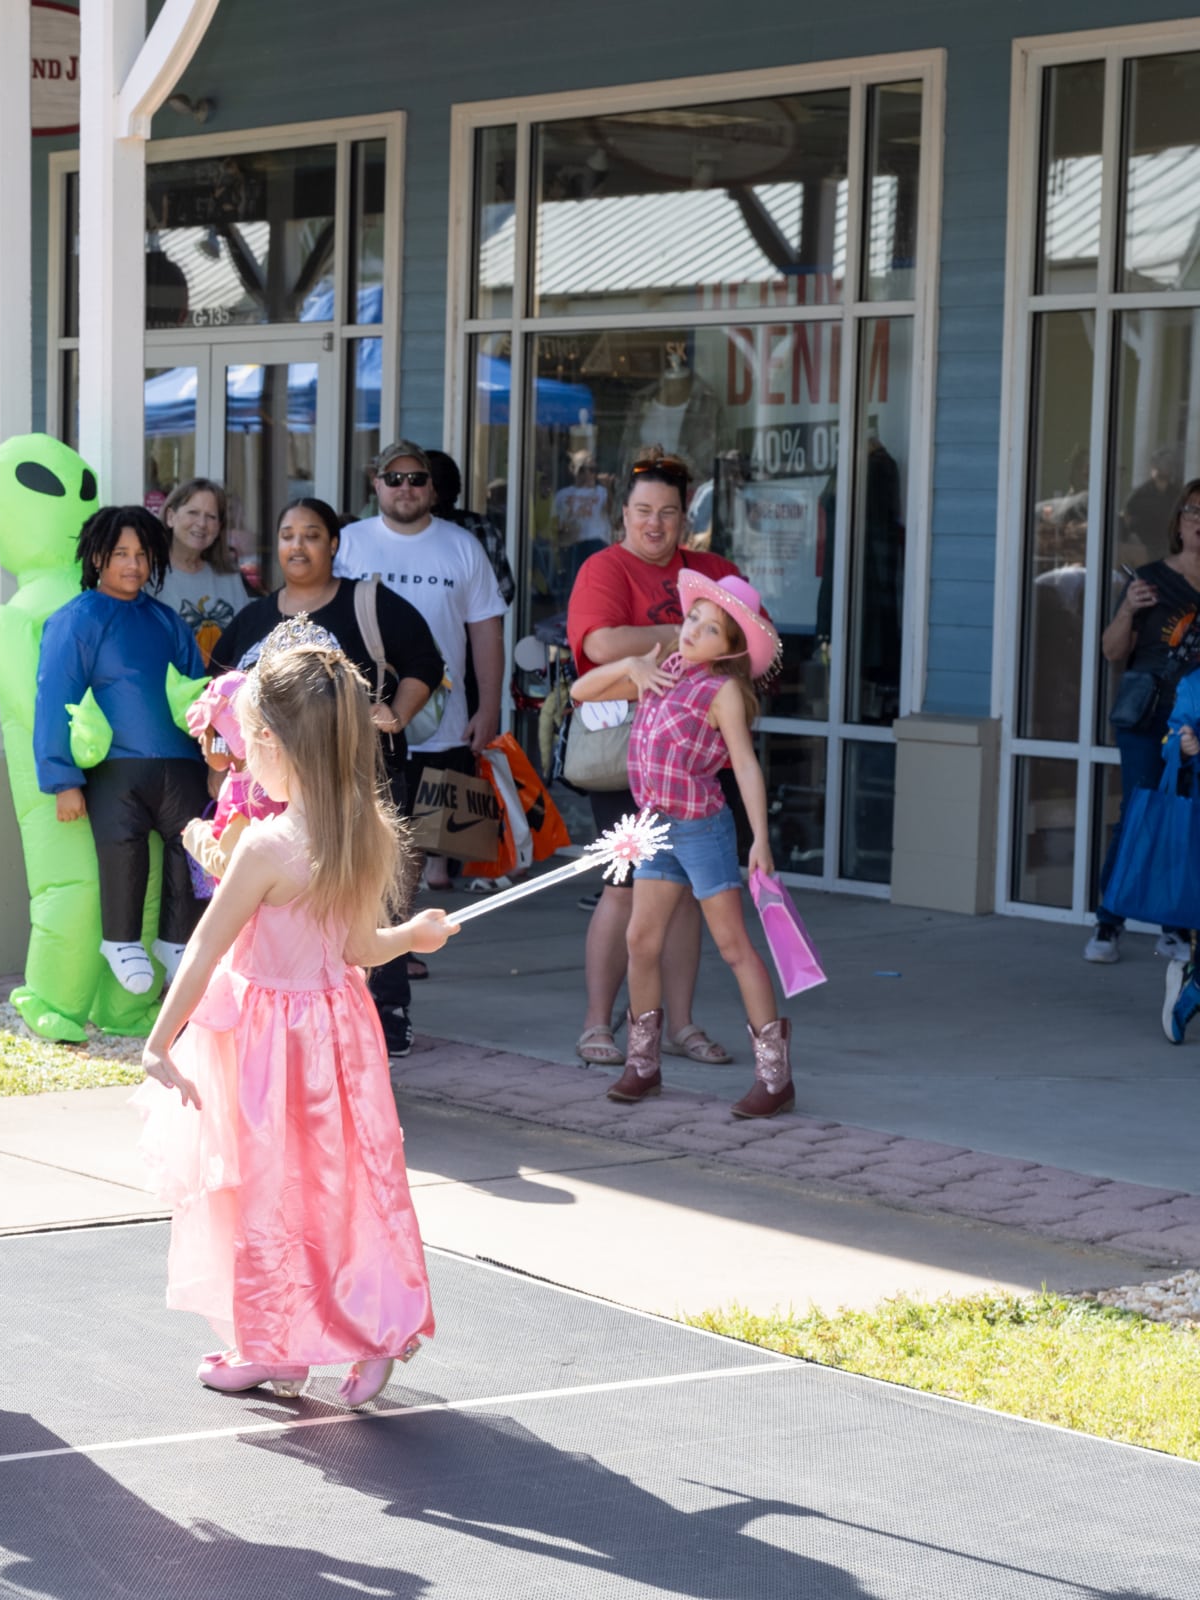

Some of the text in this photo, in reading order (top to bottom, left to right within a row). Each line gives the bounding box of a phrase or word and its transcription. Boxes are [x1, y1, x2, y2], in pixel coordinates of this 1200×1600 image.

[726, 319, 890, 406] DENIM
[751, 426, 840, 474] 40% OF
[361, 572, 454, 588] FEEDOM
[416, 782, 458, 810] NIKE
